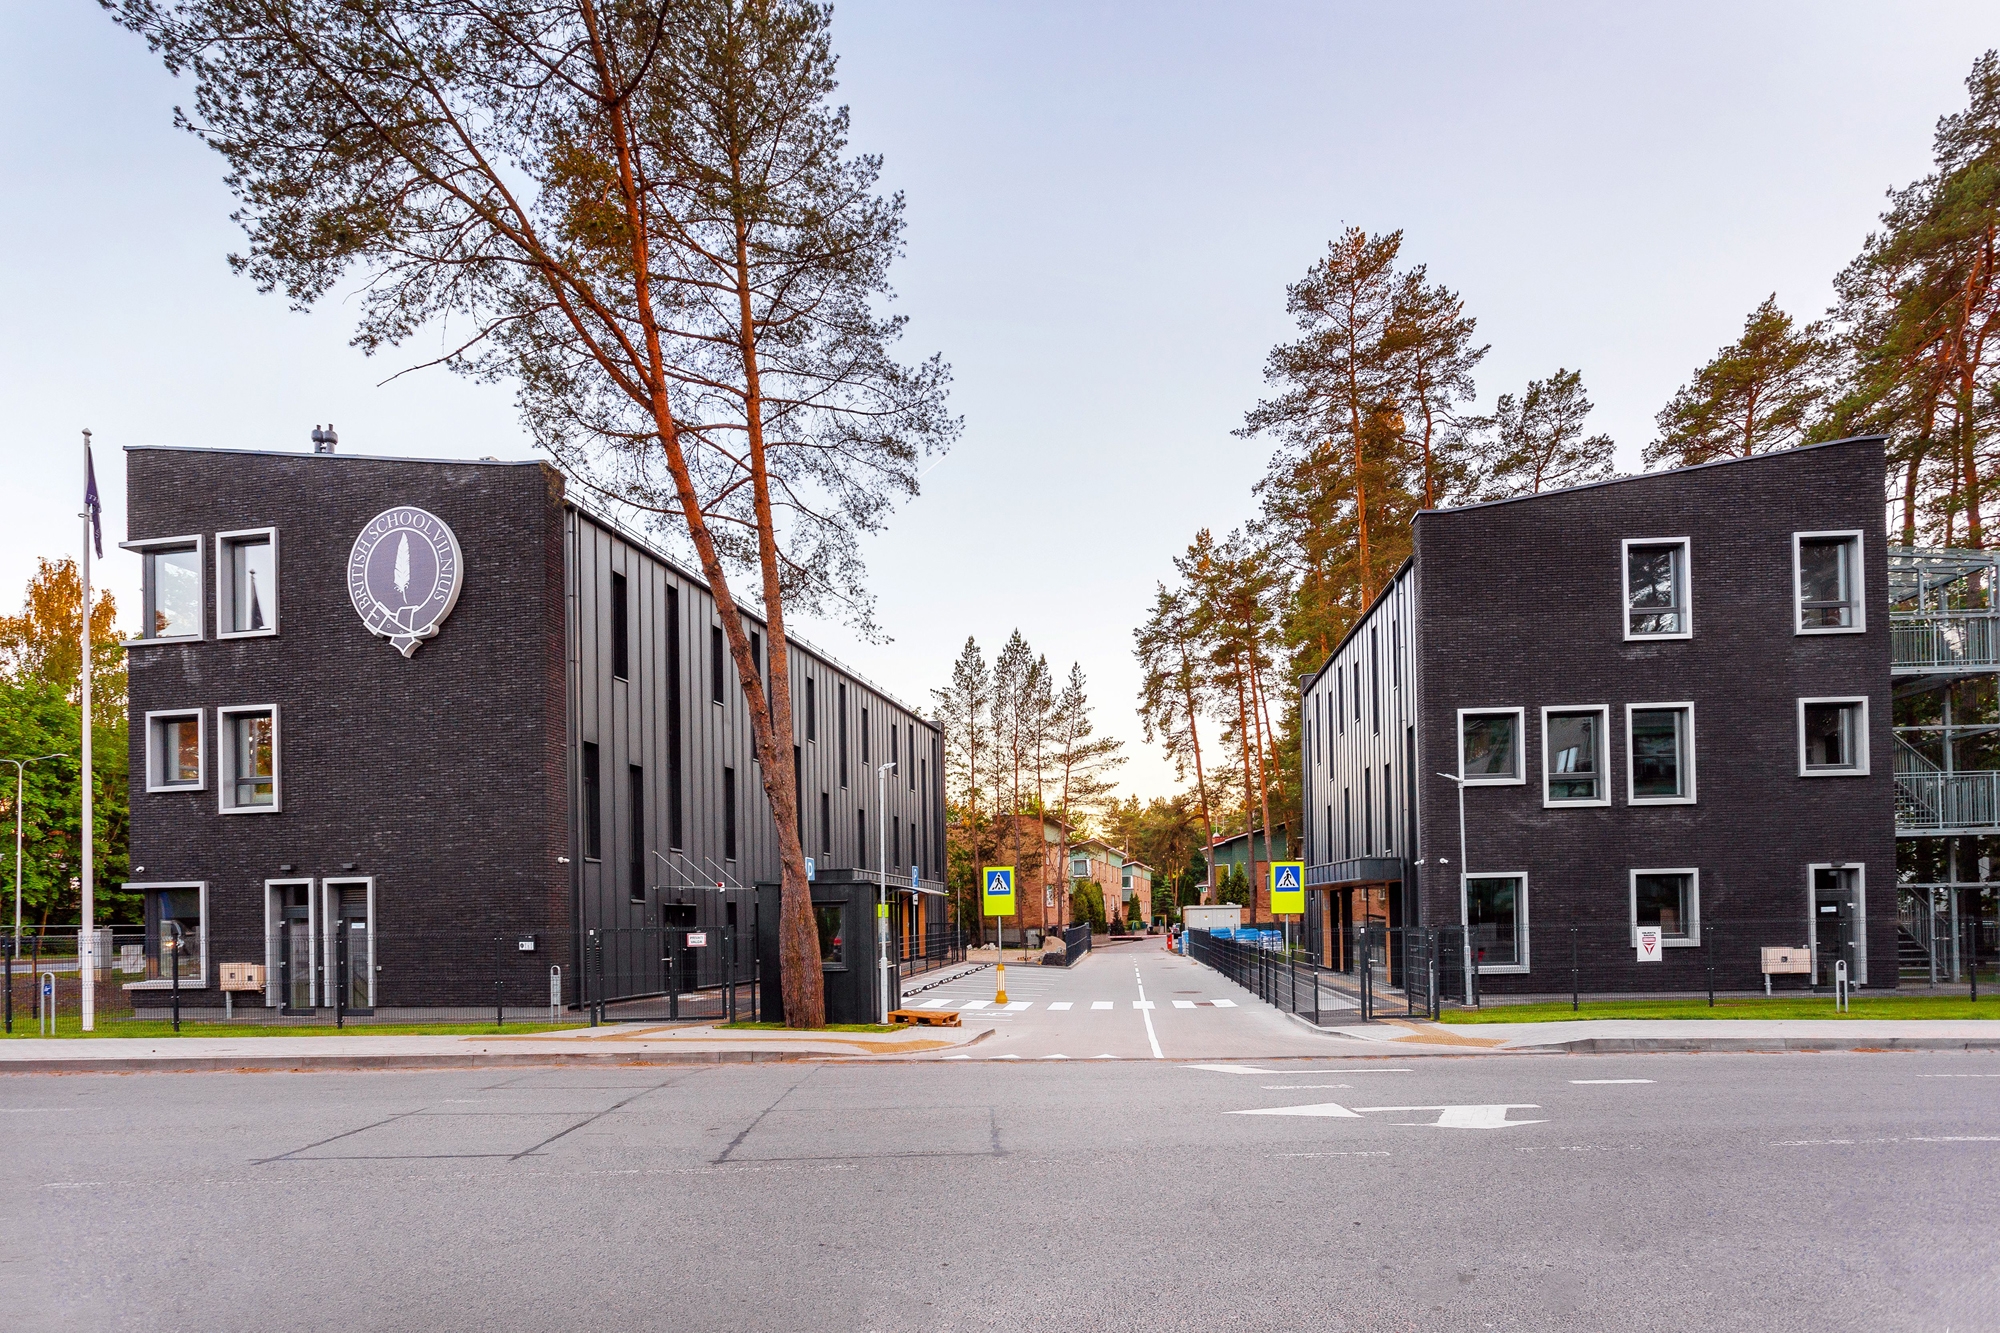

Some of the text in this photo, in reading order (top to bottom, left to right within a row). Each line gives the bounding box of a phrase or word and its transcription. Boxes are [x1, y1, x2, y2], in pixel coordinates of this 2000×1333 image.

[352, 511, 453, 610] BRITISH SCHOOL VILNIUS
